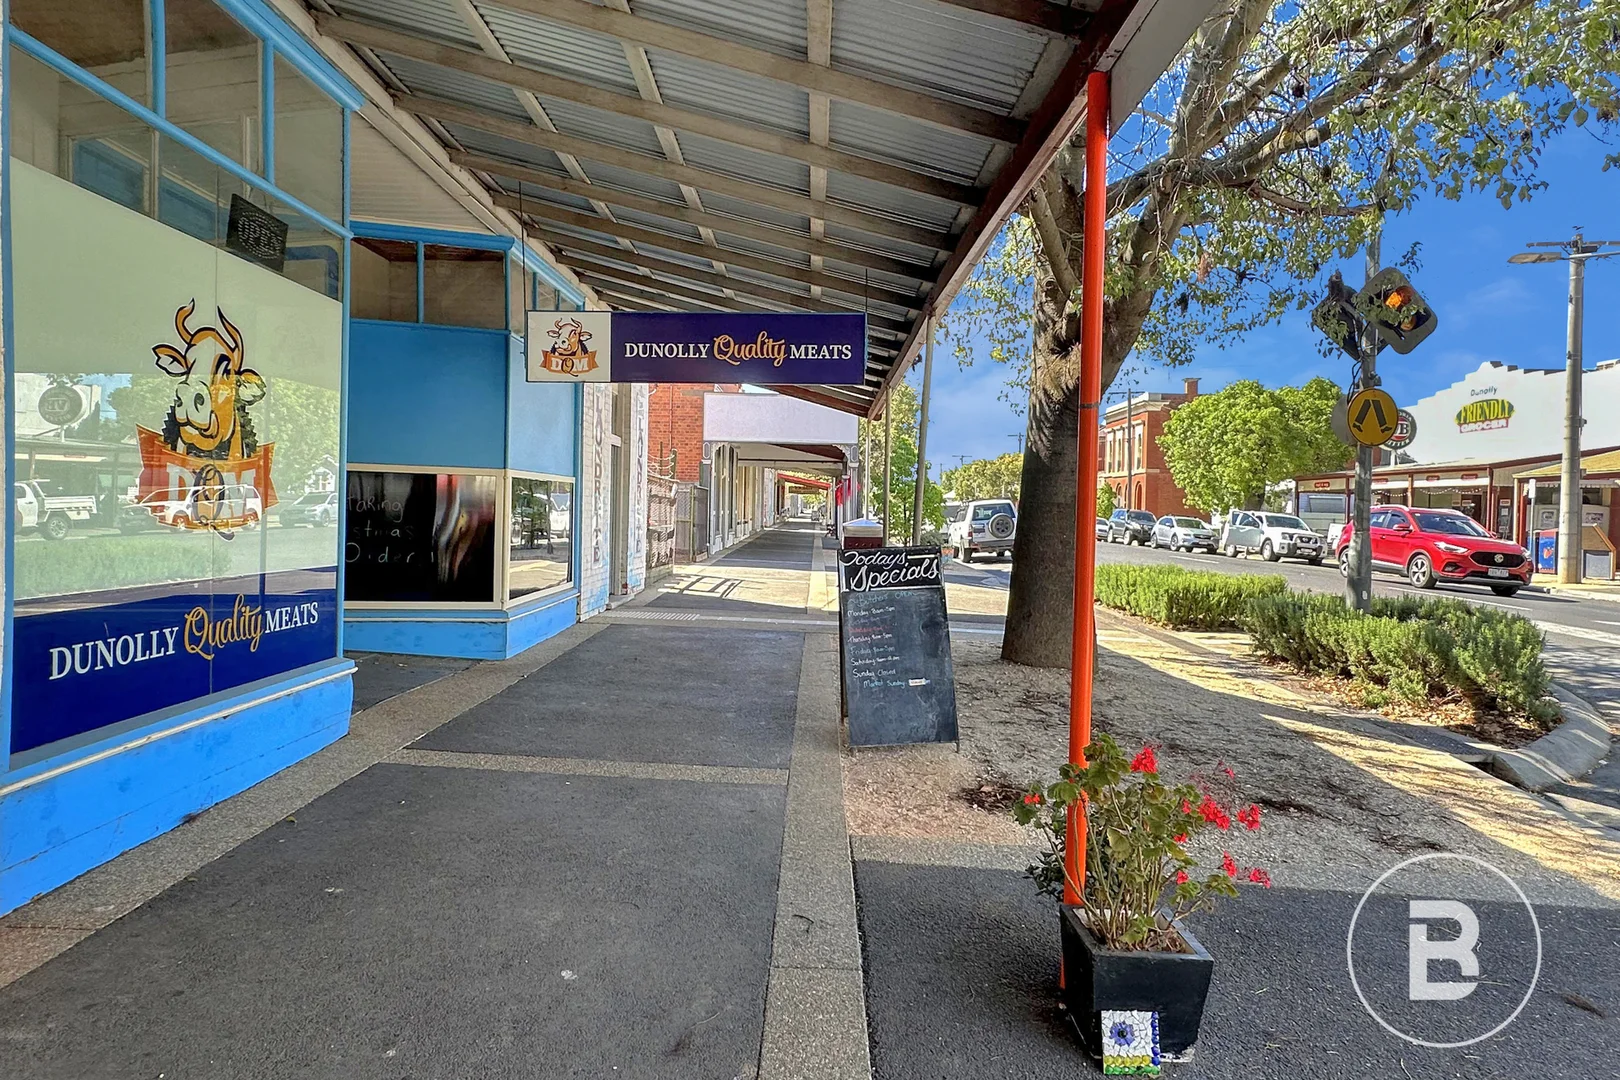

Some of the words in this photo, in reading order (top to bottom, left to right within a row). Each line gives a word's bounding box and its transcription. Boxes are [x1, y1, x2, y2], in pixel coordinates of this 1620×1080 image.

[238, 217, 283, 255] OPEN
[625, 343, 710, 358] DUNOLLY
[713, 331, 787, 366] Quality
[789, 344, 852, 359] MEATS
[550, 357, 589, 377] DQM
[1470, 386, 1498, 396] Dunolly
[1460, 399, 1510, 423] FRIENDLY
[840, 551, 906, 569] Todays
[850, 558, 940, 592] Specials
[49, 626, 179, 680] DUNOLLY
[184, 593, 265, 660] Quality
[264, 602, 319, 633] MEATS
